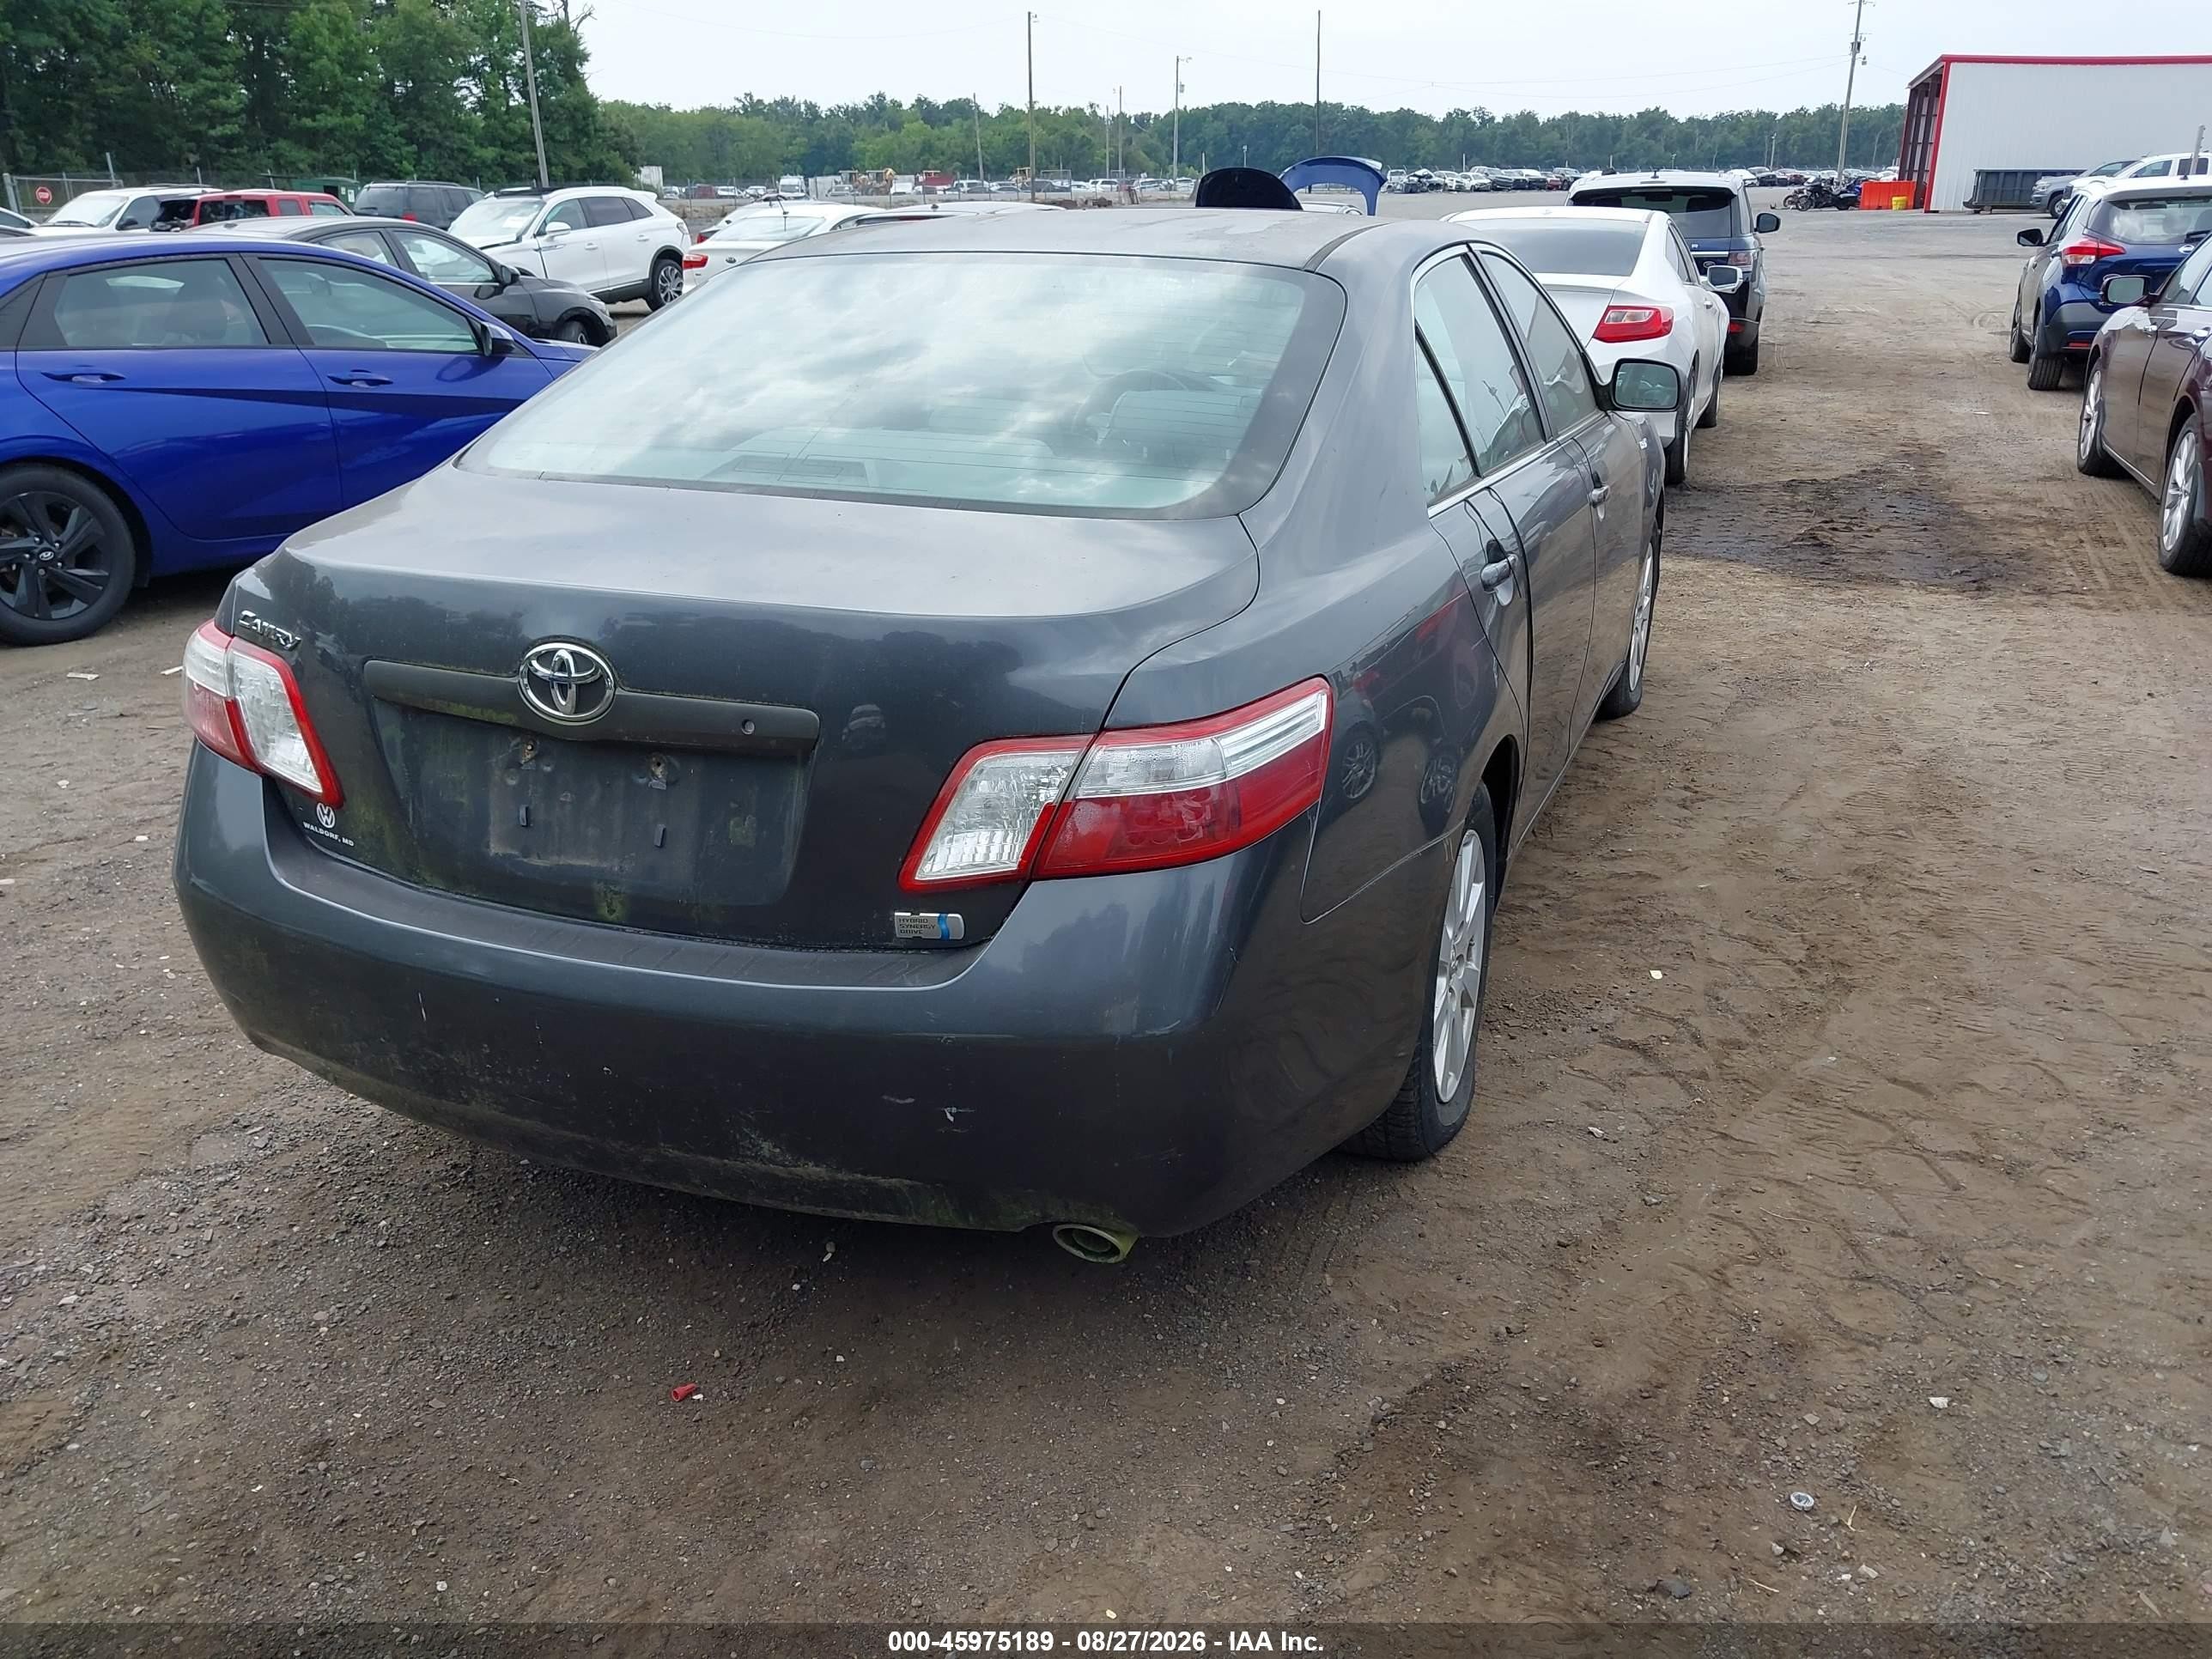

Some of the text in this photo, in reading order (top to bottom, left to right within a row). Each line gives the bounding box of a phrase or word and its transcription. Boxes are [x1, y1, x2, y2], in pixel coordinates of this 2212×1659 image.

[239, 610, 302, 650] CAMRY
[303, 821, 355, 847] WALDORF, MD
